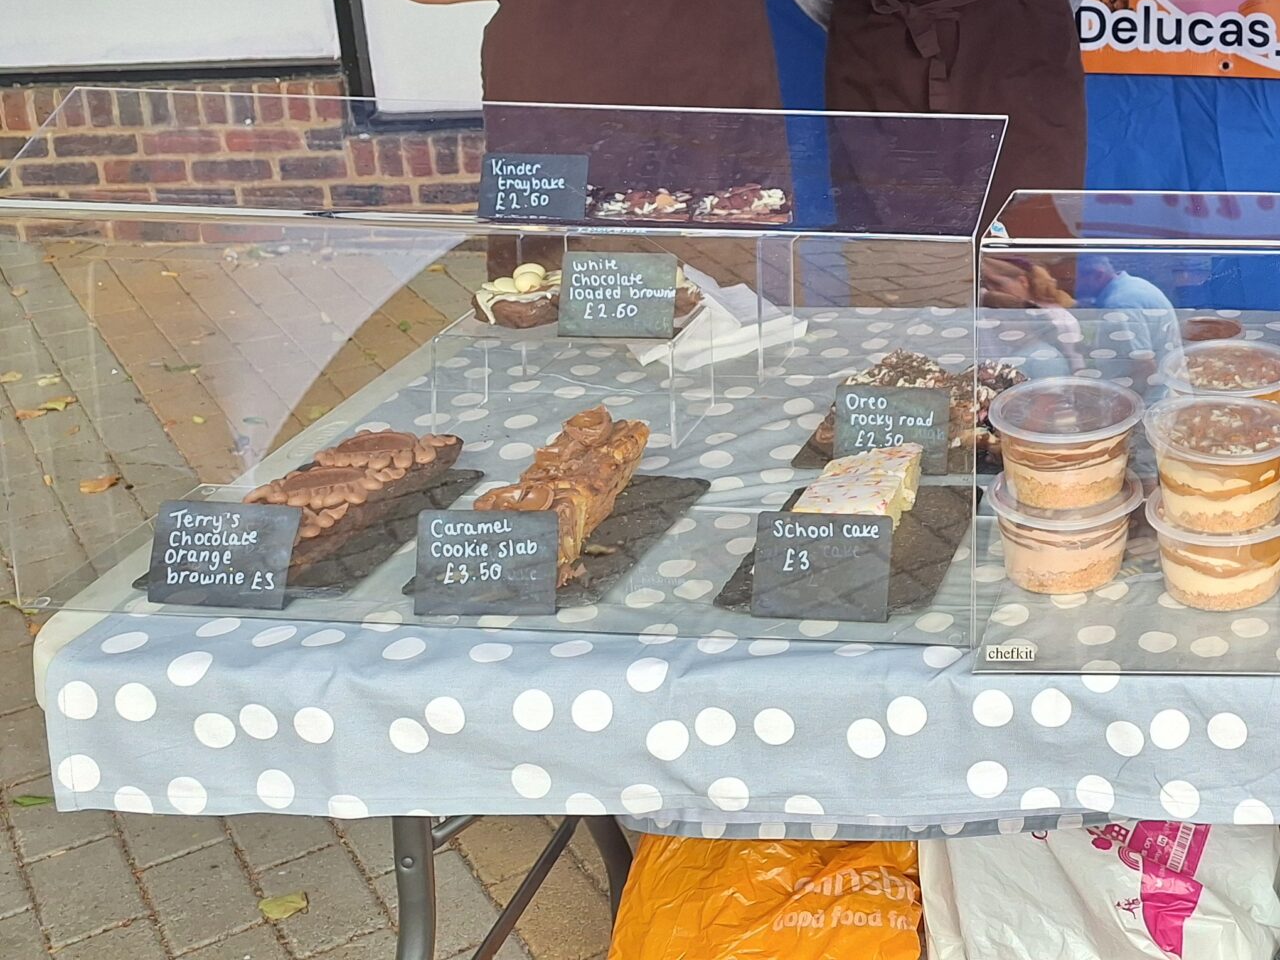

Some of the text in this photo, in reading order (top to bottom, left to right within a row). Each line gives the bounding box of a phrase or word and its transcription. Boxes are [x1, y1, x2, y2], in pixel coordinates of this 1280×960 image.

[491, 158, 541, 176] Kinder
[497, 176, 566, 196] traybake
[569, 286, 621, 300] loaded
[845, 393, 888, 410] Oreo
[850, 410, 935, 431] rocky road
[854, 429, 905, 448] £2.50
[169, 508, 241, 534] Terry's
[430, 519, 512, 539] Caramel
[773, 520, 880, 539] School cake
[783, 548, 810, 571] £3
[166, 567, 244, 585] brownie
[443, 561, 502, 585] £3.50
[988, 647, 1033, 660] chefkit
[831, 906, 882, 928] food
